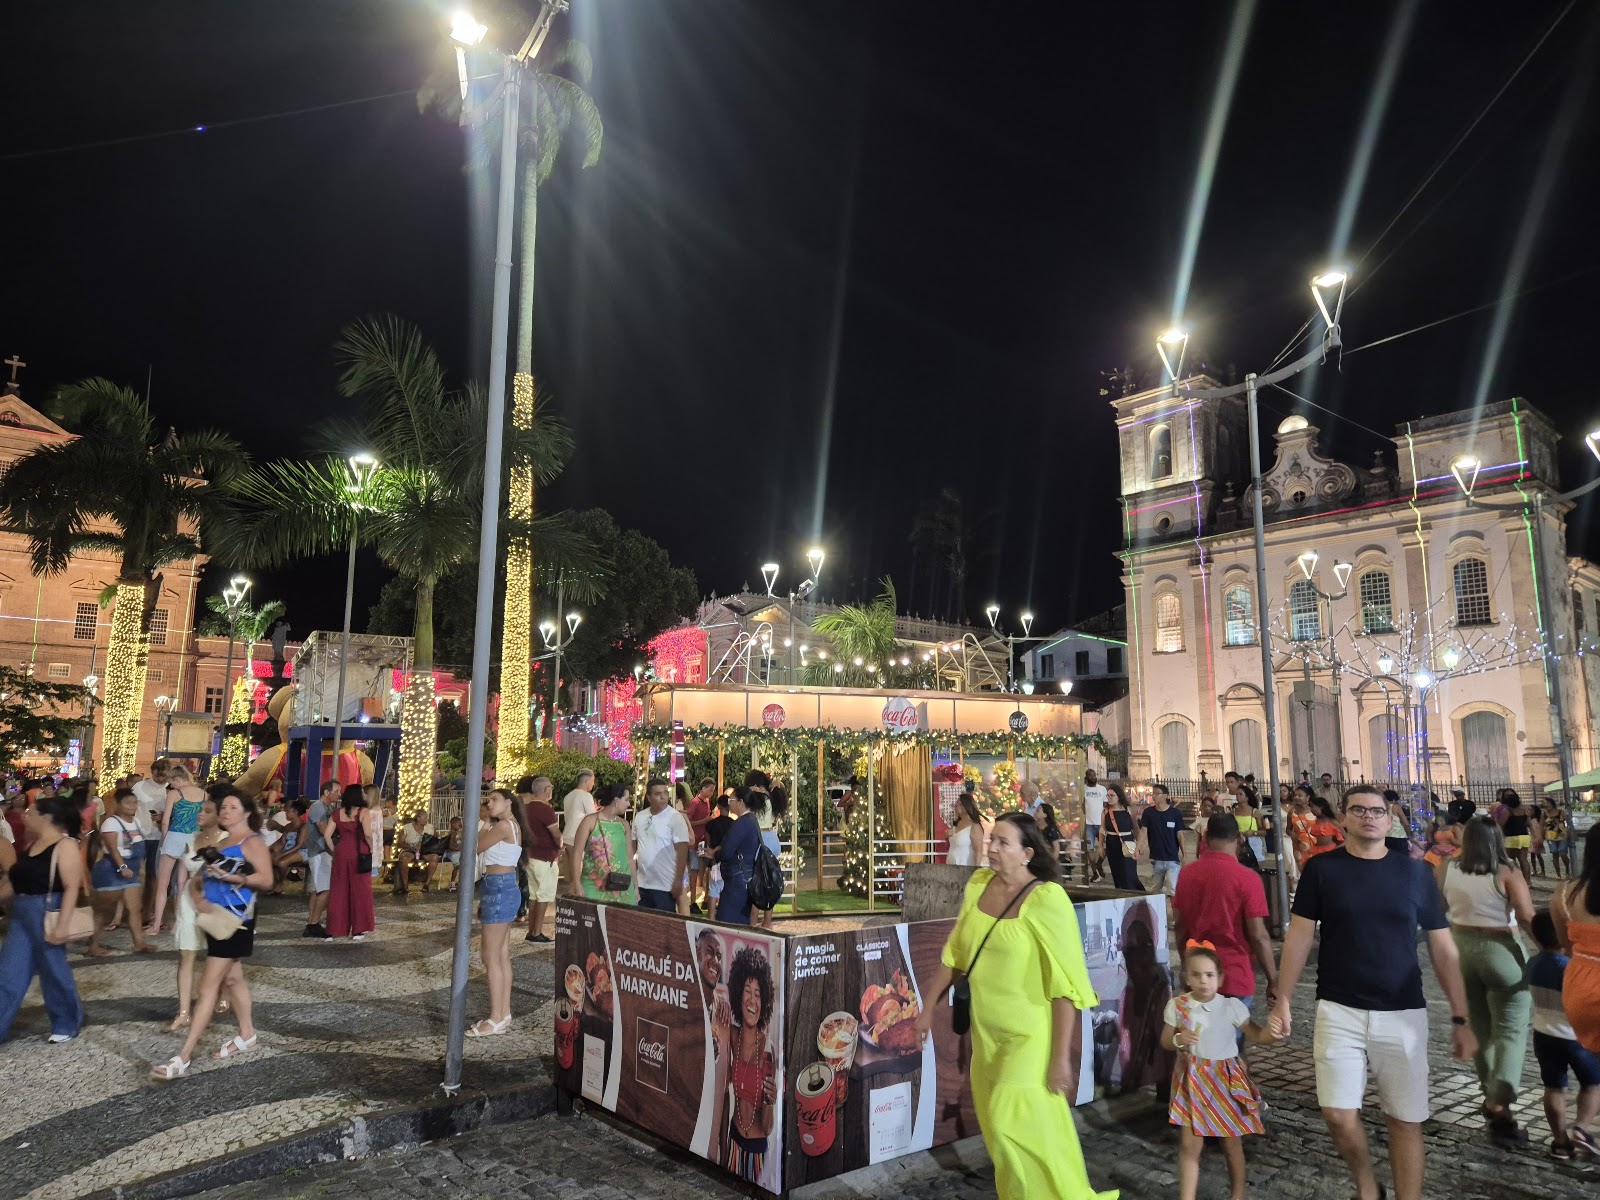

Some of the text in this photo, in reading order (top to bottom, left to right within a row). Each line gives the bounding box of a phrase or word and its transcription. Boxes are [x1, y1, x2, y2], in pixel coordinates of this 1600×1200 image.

[795, 941, 835, 956] A magia
[615, 947, 695, 983] ACARAJÉ DA
[795, 953, 841, 967] de comer
[793, 965, 828, 981] juntos.
[621, 973, 688, 1009] MARYJANE
